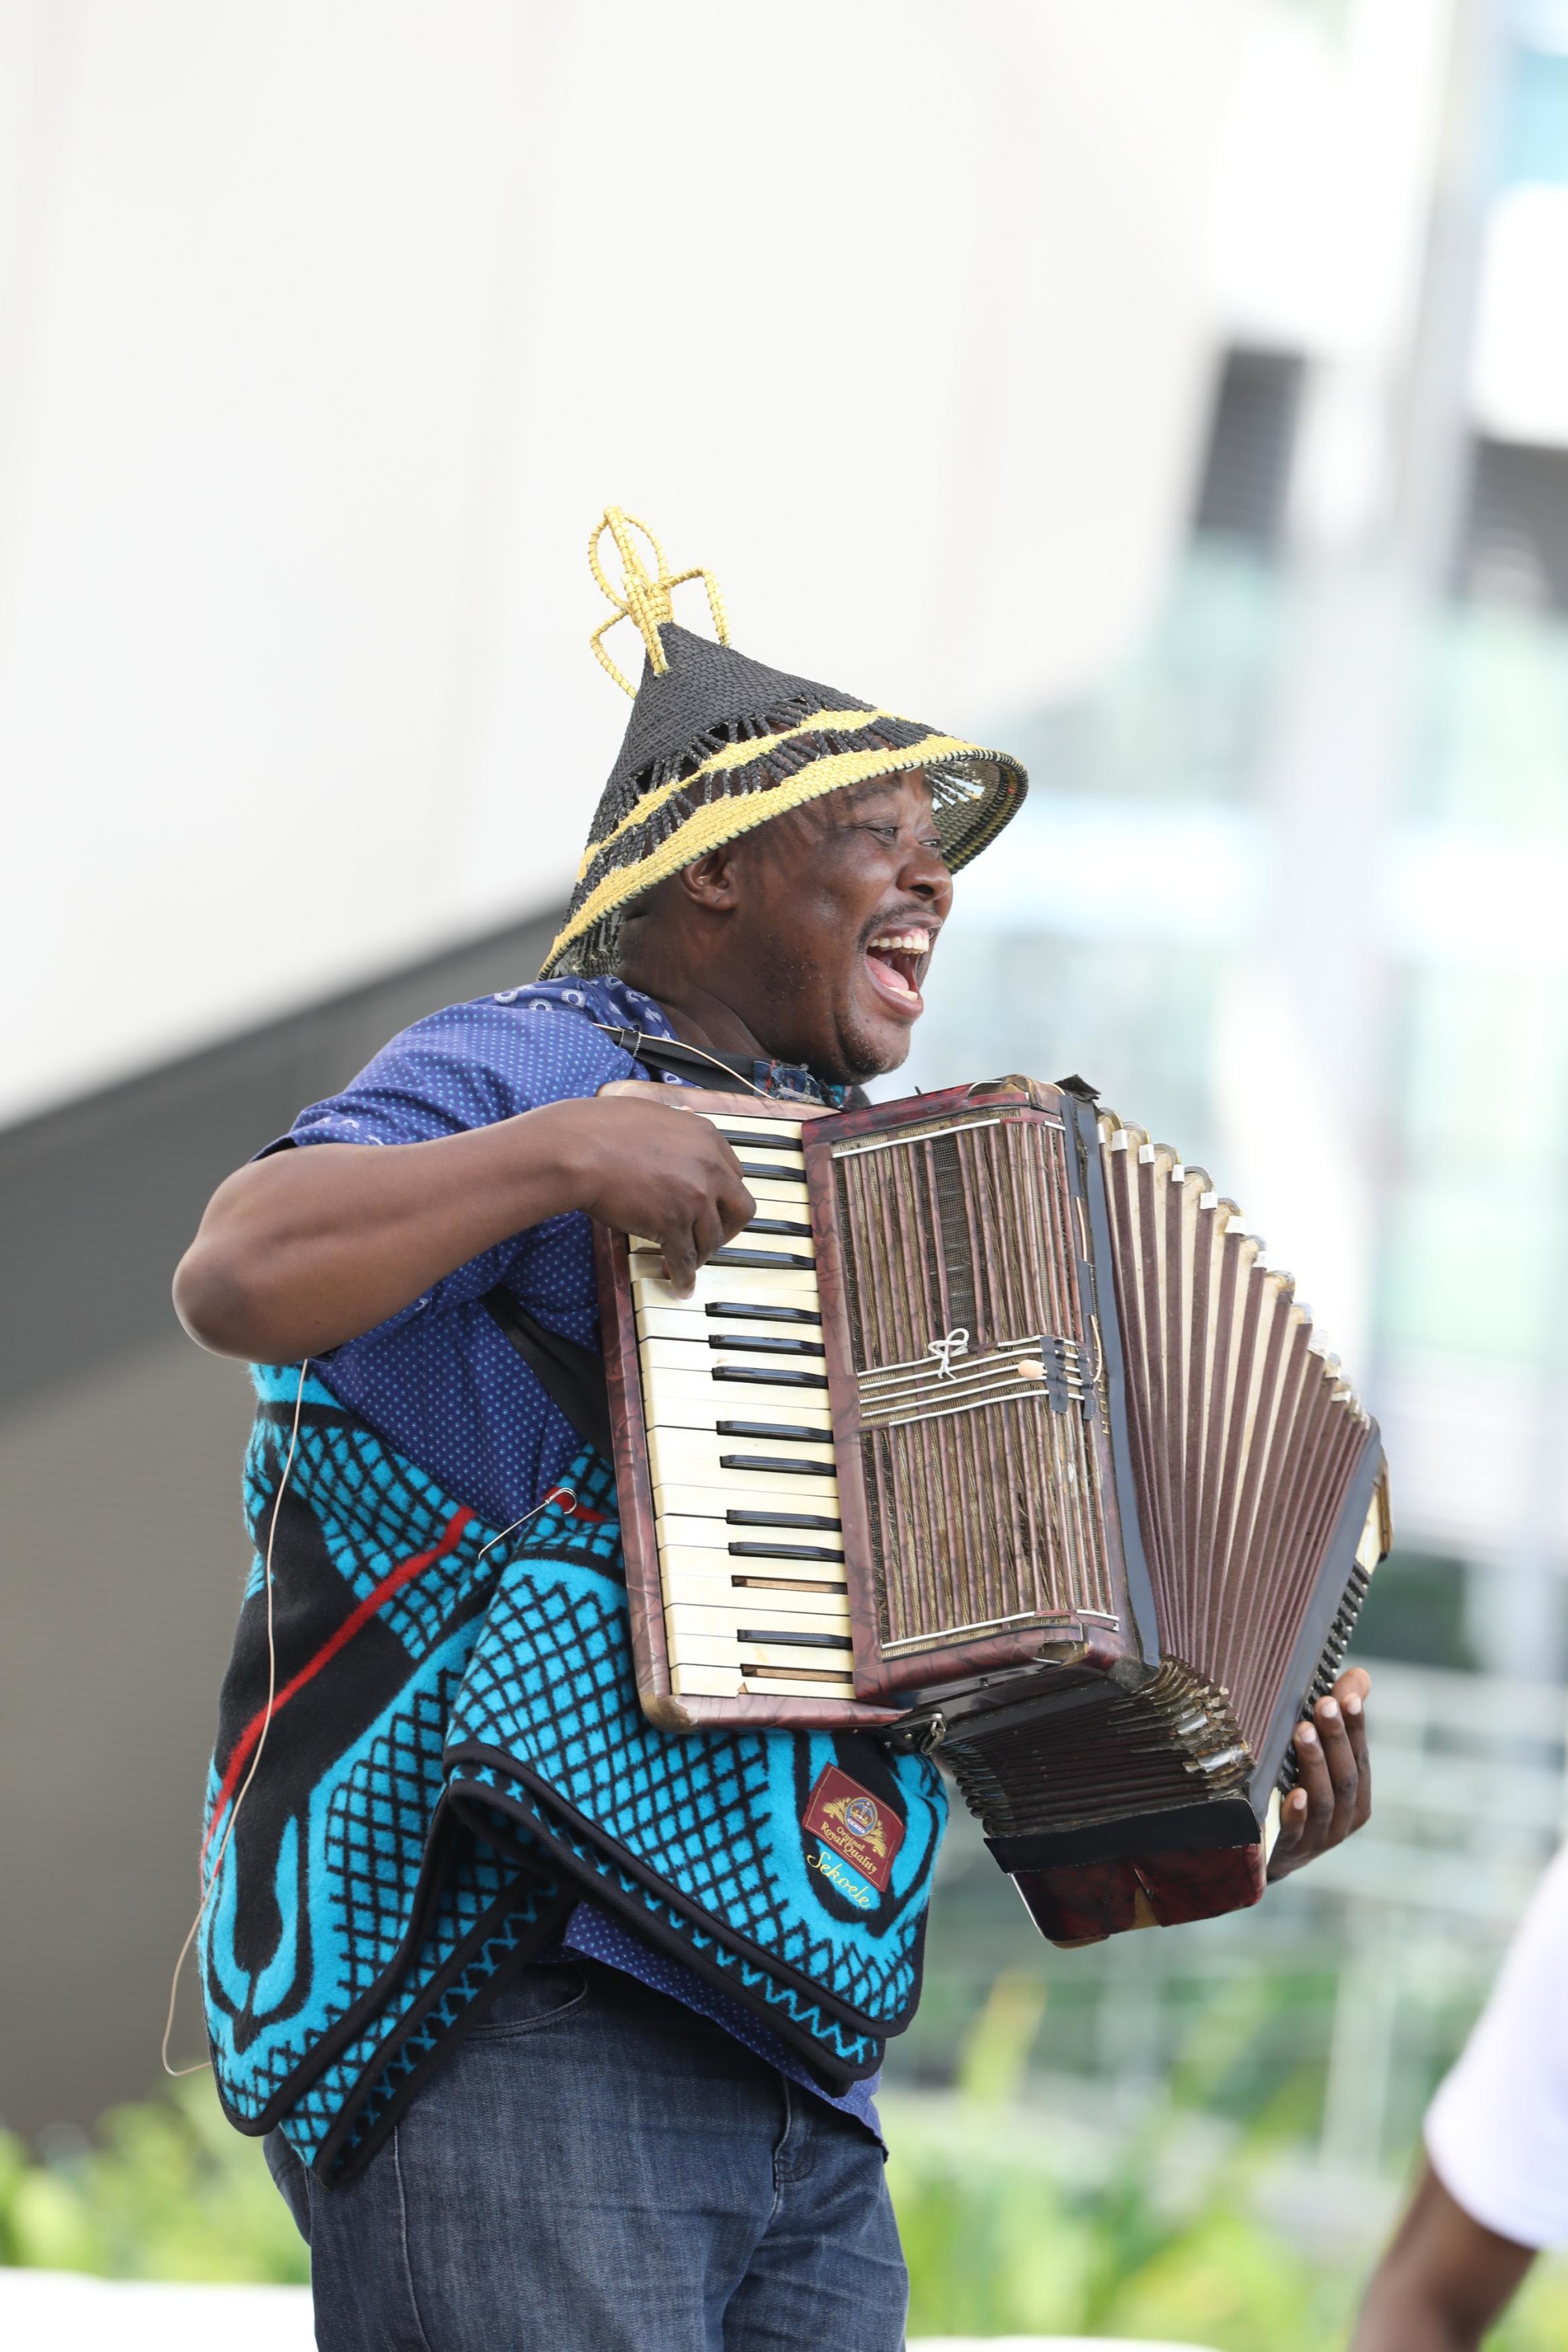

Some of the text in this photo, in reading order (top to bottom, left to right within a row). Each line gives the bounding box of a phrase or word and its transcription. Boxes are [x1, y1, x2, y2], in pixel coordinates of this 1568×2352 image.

[821, 1820, 844, 1846] Royal
[843, 1843, 877, 1875] Quality
[837, 1826, 865, 1851] Original
